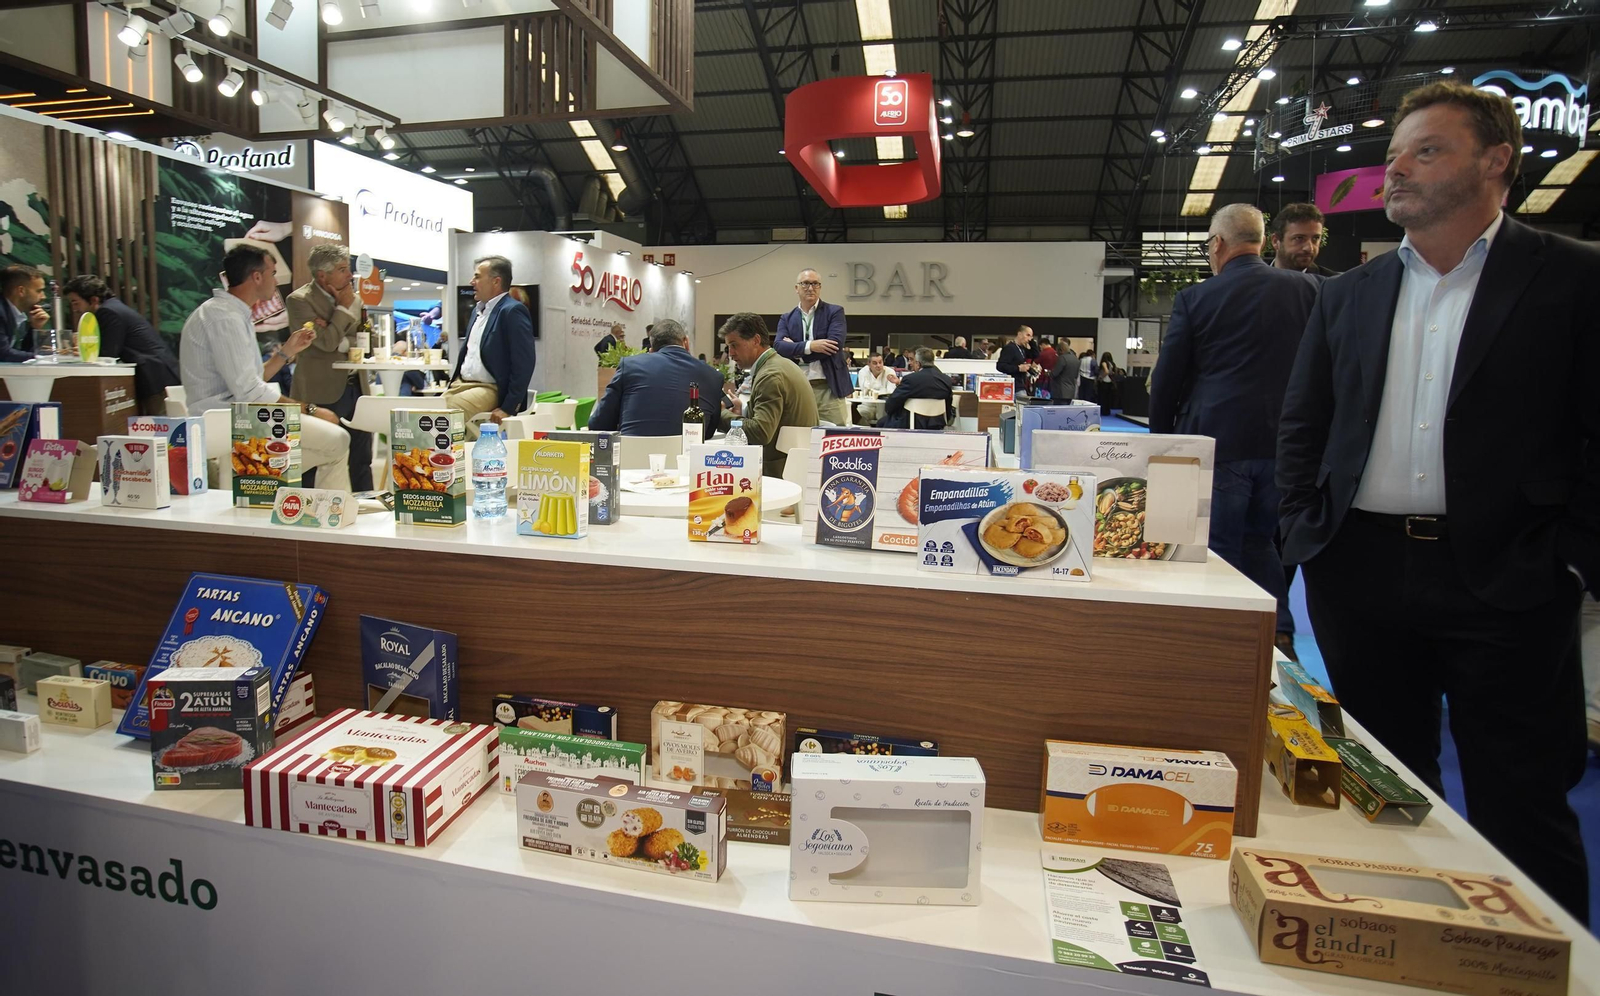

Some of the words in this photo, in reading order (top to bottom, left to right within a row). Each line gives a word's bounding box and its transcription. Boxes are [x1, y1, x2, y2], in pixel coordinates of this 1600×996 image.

[880, 86, 903, 106] 50
[1287, 135, 1306, 146] PRIM
[1318, 125, 1352, 138] STARS
[384, 202, 443, 233] Profand
[570, 252, 594, 296] 50
[845, 261, 954, 302] BAR
[140, 424, 169, 432] CONAD
[822, 438, 882, 452] PESCANOVA
[1091, 446, 1136, 460] Seleção
[829, 456, 872, 471] Rodolfos
[696, 471, 734, 488] Flan
[826, 480, 840, 492] UNA
[240, 484, 278, 492] MOZZARELLA
[930, 487, 989, 502] Empanadillas
[403, 500, 444, 508] MOZZARELLA
[924, 503, 970, 512] Empanadilhas
[829, 516, 837, 524] DE
[838, 519, 863, 528] BIGOTES
[883, 535, 916, 545] Cocido
[992, 565, 1018, 574] HACENDADO
[196, 587, 240, 602] TARTAS
[210, 608, 274, 628] ANCANO
[380, 637, 410, 656] ROYAL
[272, 663, 294, 708] TARTAS
[294, 609, 318, 658] ANCANO
[90, 669, 128, 687] Calvo
[374, 662, 395, 670] BACALAO
[395, 664, 420, 680] DESALADO
[180, 692, 193, 712] 2
[345, 729, 430, 744] Mantecadas
[676, 748, 698, 756] AVEIRO
[1138, 756, 1211, 766] DAMACEL
[1111, 766, 1195, 784] DAMACEL
[305, 801, 358, 814] Mantecadas
[914, 798, 933, 807] Receta
[942, 799, 970, 807] tradición
[523, 814, 540, 822] FREIDORA
[1120, 805, 1170, 817] DAMACEL
[817, 830, 835, 842] Los
[798, 839, 853, 854] Segovianos
[1195, 843, 1214, 853] 75
[1318, 857, 1361, 868] SOBAO
[1363, 862, 1420, 874] PASIEGO
[0, 838, 218, 911] envasado
[1314, 917, 1334, 936] el
[1340, 918, 1398, 934] sobaos
[1314, 934, 1396, 959] andral
[1440, 928, 1492, 948] Sobao
[1495, 934, 1560, 960] Pasiego
[1324, 951, 1355, 961] GRANJA
[1357, 956, 1395, 967] OBRADOR
